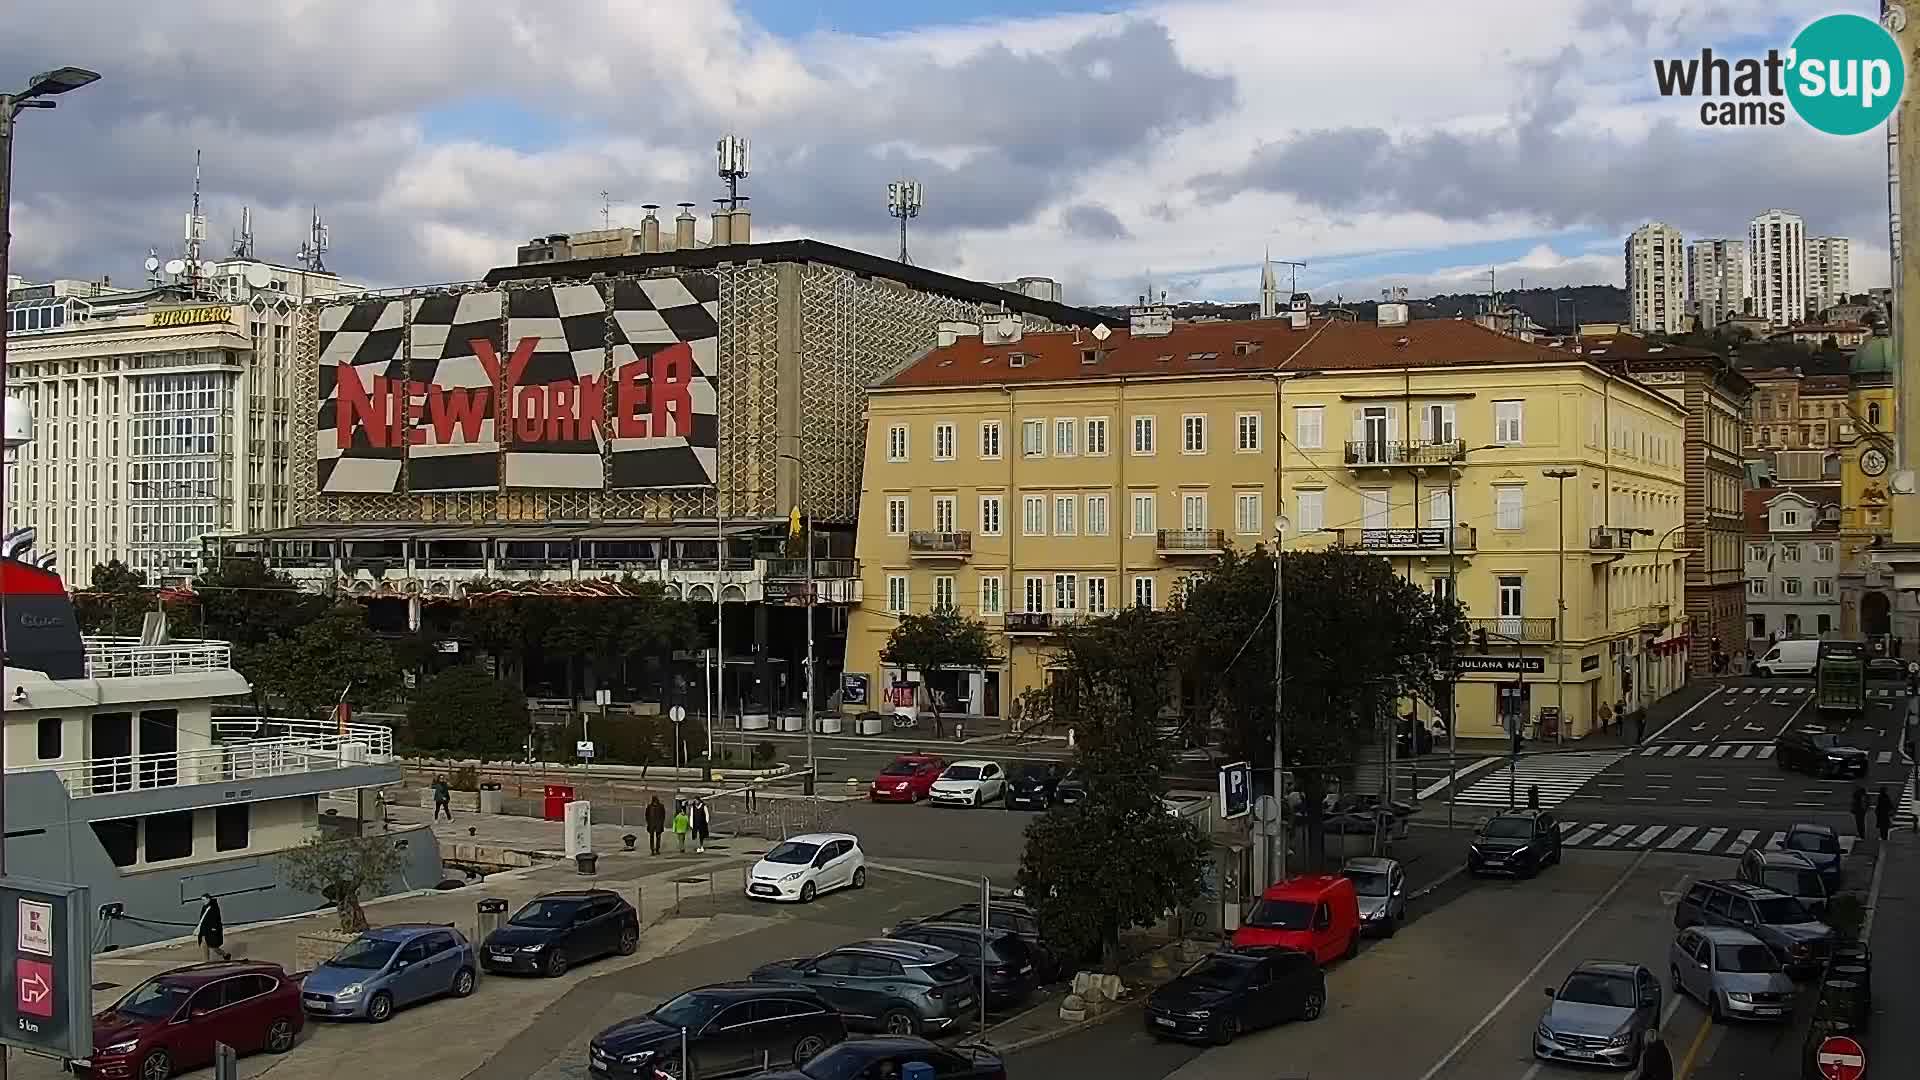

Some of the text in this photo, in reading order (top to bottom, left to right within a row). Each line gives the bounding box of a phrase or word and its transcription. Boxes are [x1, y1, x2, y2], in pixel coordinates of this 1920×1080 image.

[1457, 660, 1539, 669] JULIANA NAILS
[19, 1018, 25, 1029] 5
